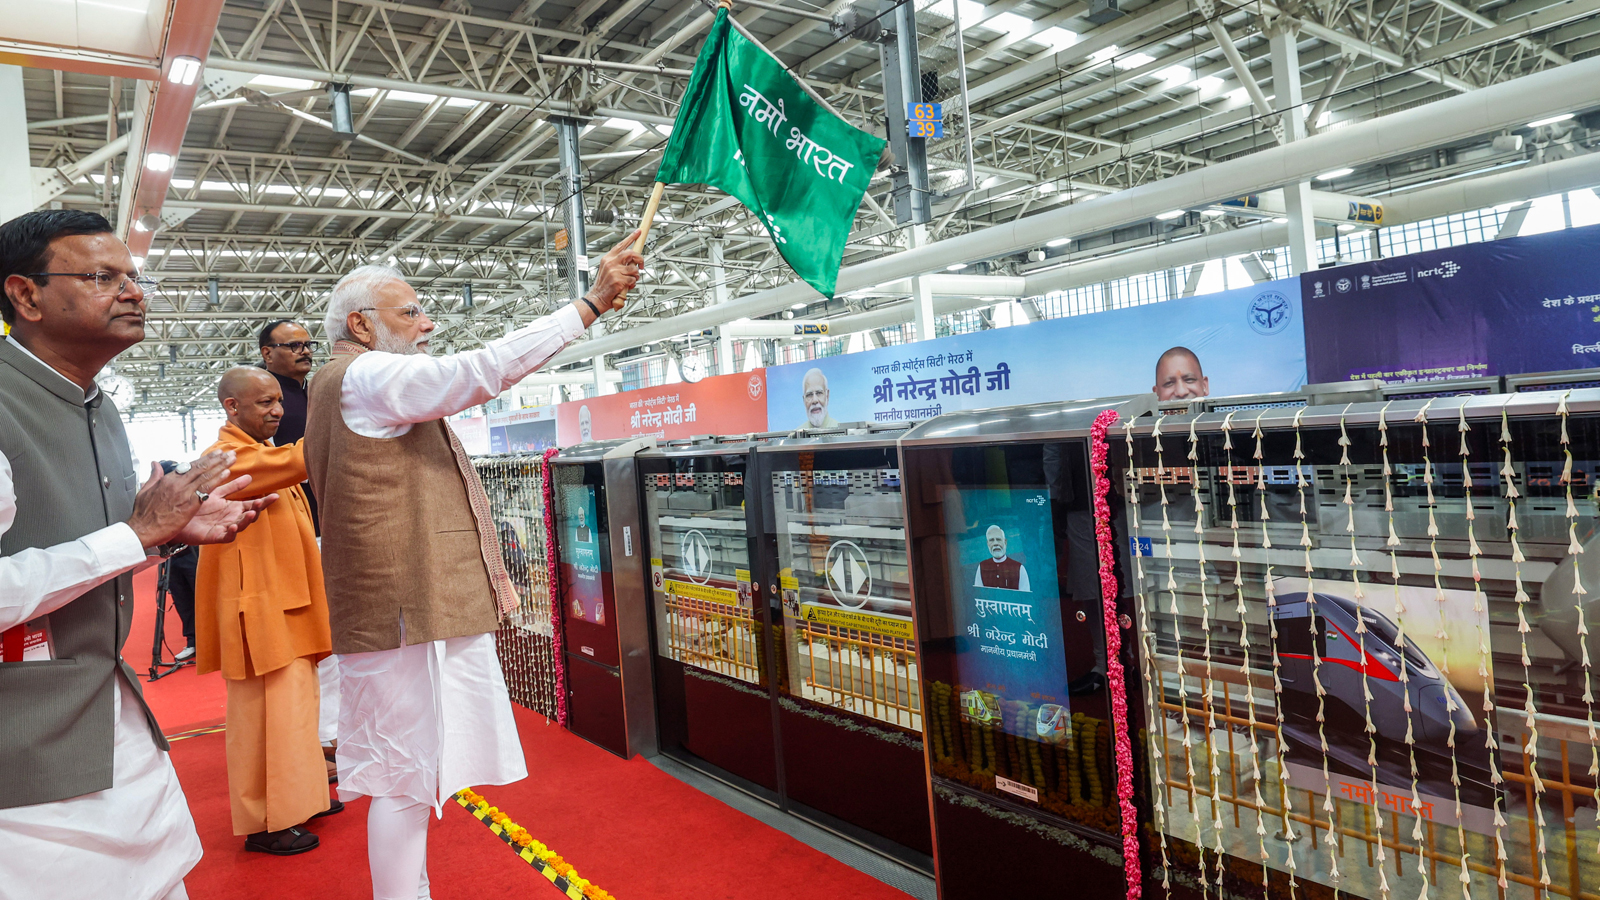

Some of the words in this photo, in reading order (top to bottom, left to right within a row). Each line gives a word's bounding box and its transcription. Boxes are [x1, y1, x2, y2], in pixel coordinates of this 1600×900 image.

[915, 104, 934, 119] 63
[738, 83, 787, 137] नमो
[785, 126, 854, 184] भारत
[917, 122, 935, 136] 39
[1417, 267, 1444, 278] ncrtc
[1542, 298, 1561, 308] देश
[1563, 295, 1574, 305] के
[891, 360, 900, 372] की
[948, 352, 964, 364] मेरठ
[873, 378, 893, 404] श्री
[896, 375, 936, 400] नरेन्द्र
[940, 366, 981, 396] मोदी
[985, 362, 1010, 390] जी
[631, 410, 640, 428] श्री
[642, 409, 662, 427] नरेन्द्र
[663, 405, 683, 425] मोदी
[684, 403, 696, 422] जी
[874, 408, 902, 422] माननीय
[904, 404, 942, 420] प्रधानमंत्री
[974, 598, 1035, 624] सुस्वागतम्
[967, 623, 980, 638] श्री
[985, 626, 1016, 646] नरेन्द्र
[1022, 630, 1048, 648] मोदी
[980, 644, 1005, 656] माननीय
[1006, 649, 1037, 662] प्रधानमंत्री
[1339, 782, 1376, 804] नमो
